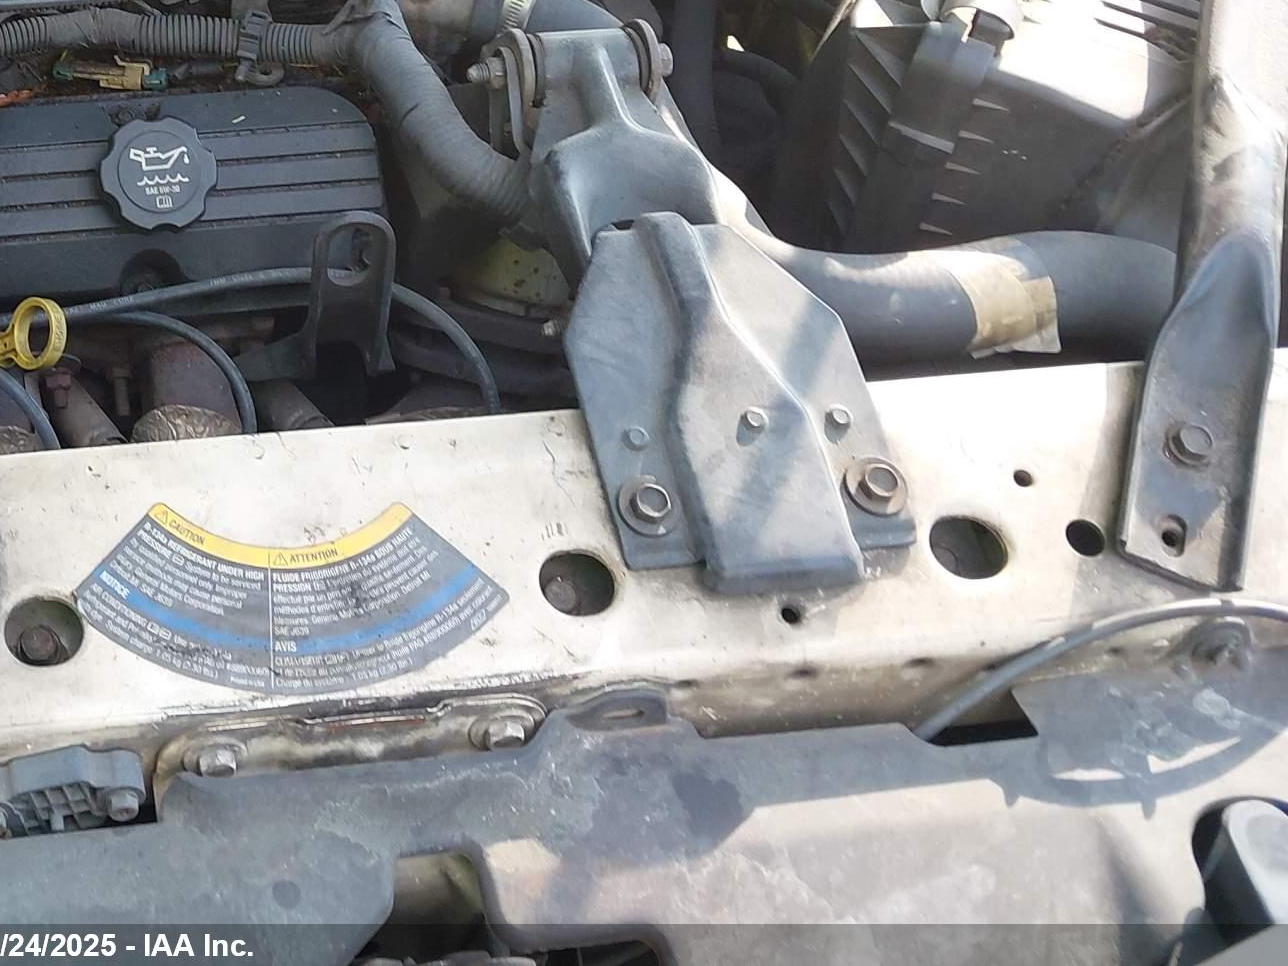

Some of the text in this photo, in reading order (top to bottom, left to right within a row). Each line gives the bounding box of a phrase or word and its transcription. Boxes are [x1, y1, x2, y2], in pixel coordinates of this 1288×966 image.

[145, 186, 159, 195] SAE
[168, 520, 205, 545] CAUTION
[137, 529, 173, 559] PRESSURE
[168, 539, 217, 569] REFRIGERANT
[218, 560, 244, 577] UNDER
[245, 568, 264, 581] HIGH
[289, 548, 338, 563] ATTENTION
[99, 570, 131, 600] NOTICE
[273, 582, 312, 593] PRESSION
[274, 640, 297, 652] AVIS
